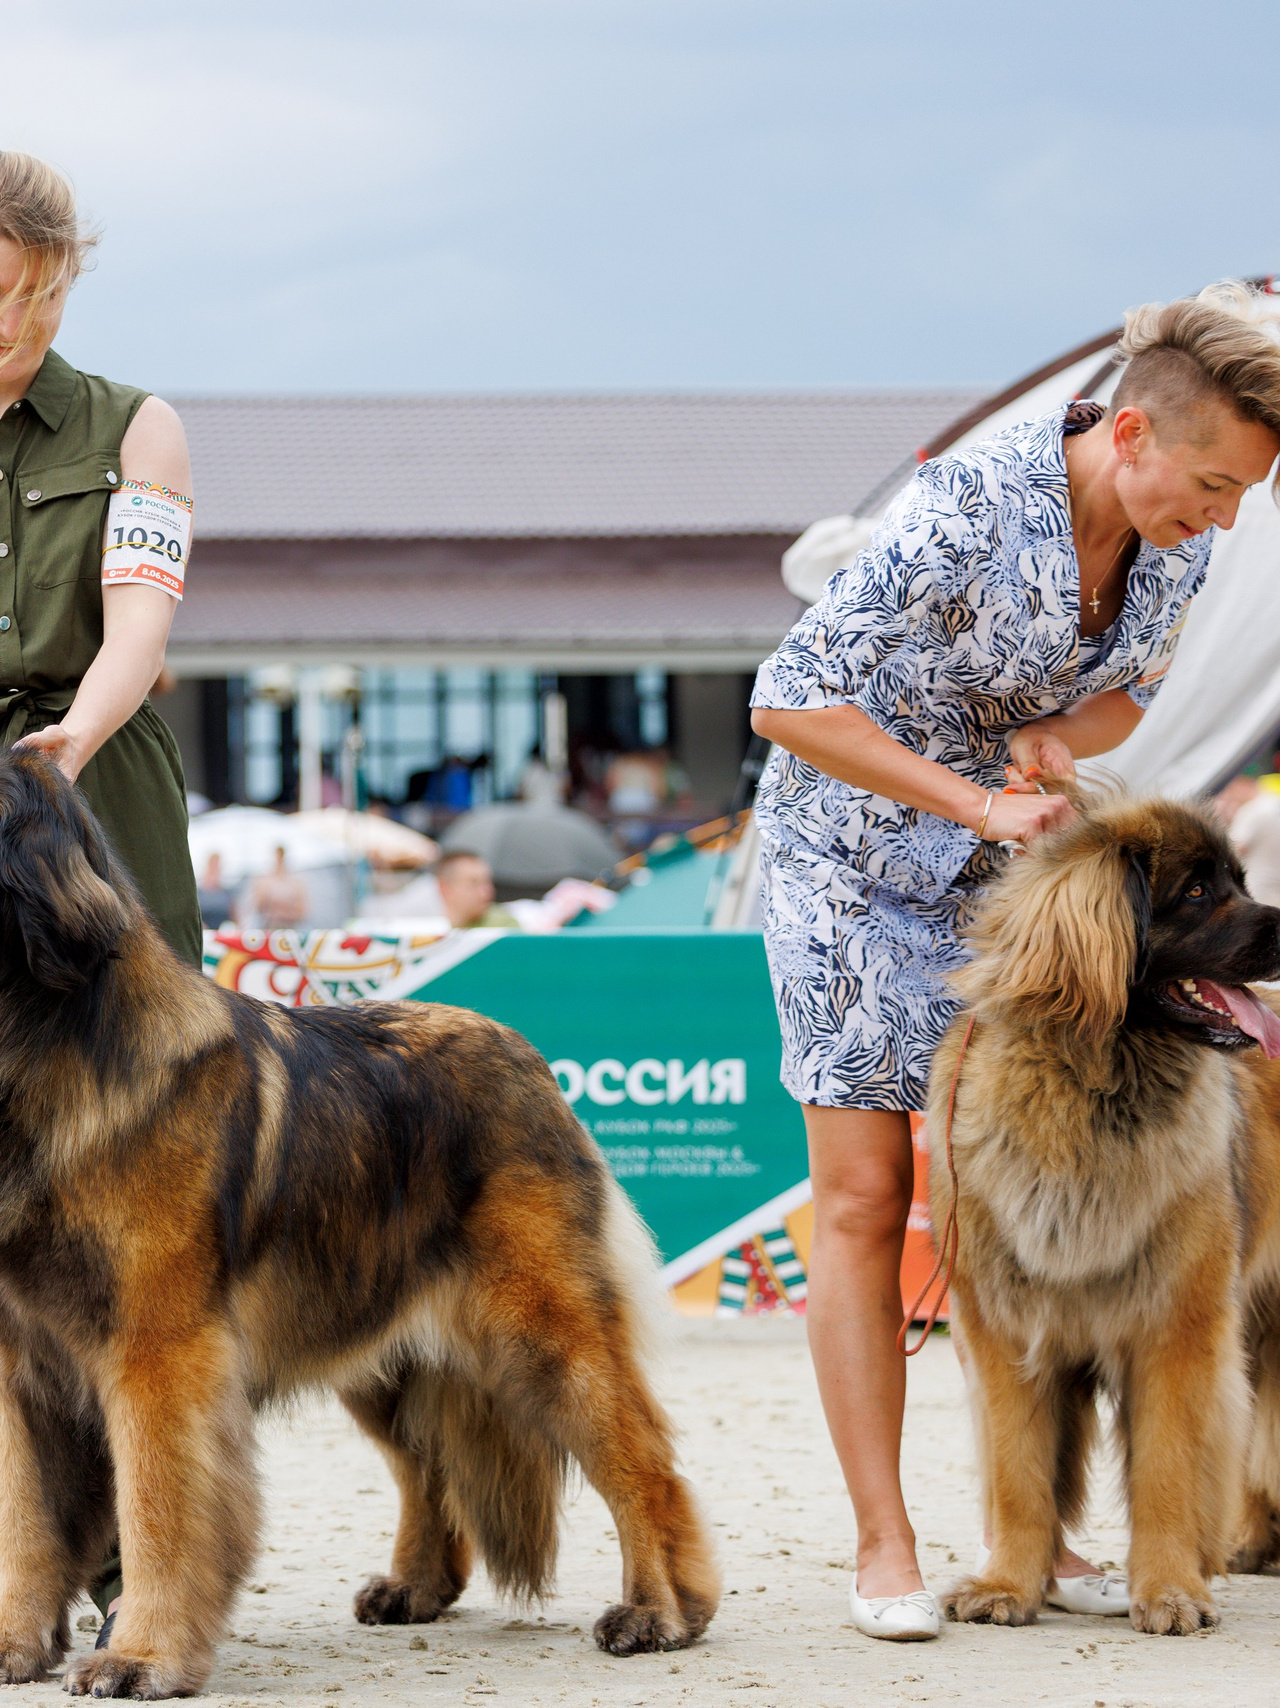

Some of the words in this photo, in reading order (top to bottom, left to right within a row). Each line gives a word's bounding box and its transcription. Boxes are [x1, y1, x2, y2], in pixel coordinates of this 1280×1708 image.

[145, 499, 176, 515] РОССИЯ
[113, 527, 182, 563] 1020
[142, 568, 179, 589] 8.06.2025
[548, 1058, 746, 1106] ОССИЯ
